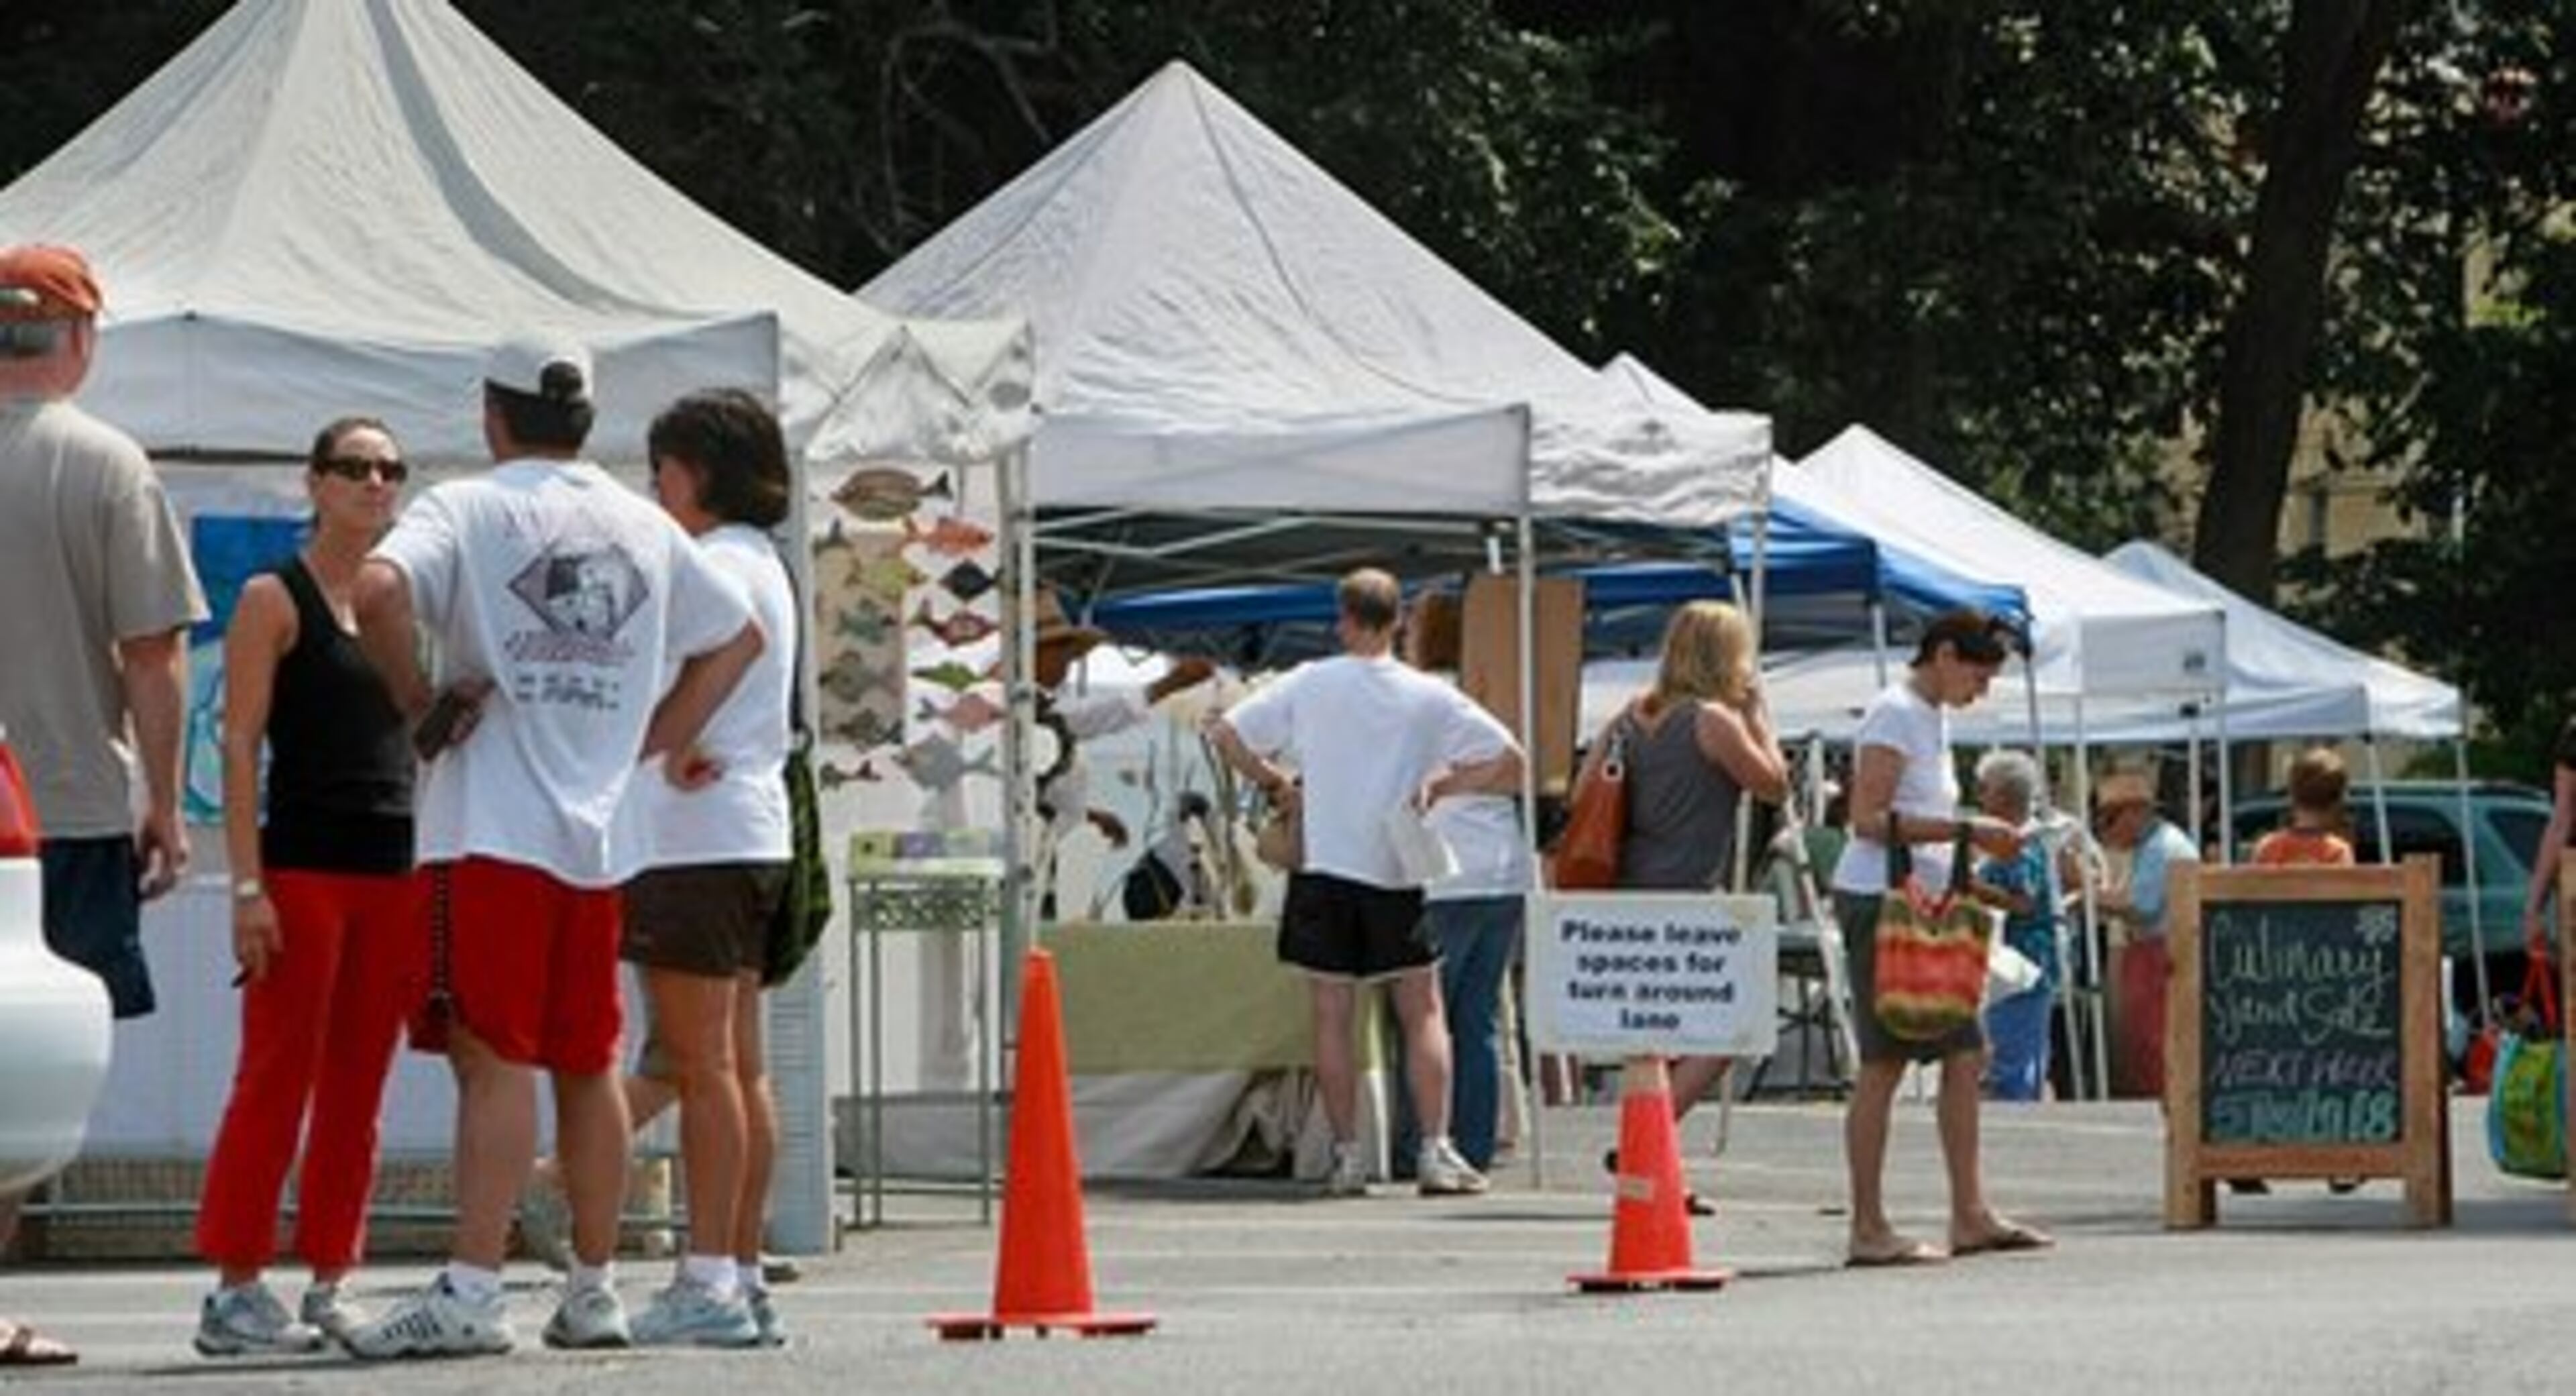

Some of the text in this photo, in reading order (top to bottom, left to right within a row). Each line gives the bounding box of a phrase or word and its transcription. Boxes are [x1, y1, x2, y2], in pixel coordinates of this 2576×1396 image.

[1562, 920, 1742, 945] Please leave
[1576, 951, 1726, 975] spaces for
[2208, 912, 2395, 1008] Culinary
[1567, 981, 1735, 1004] turn around
[1619, 1008, 1680, 1030] lane
